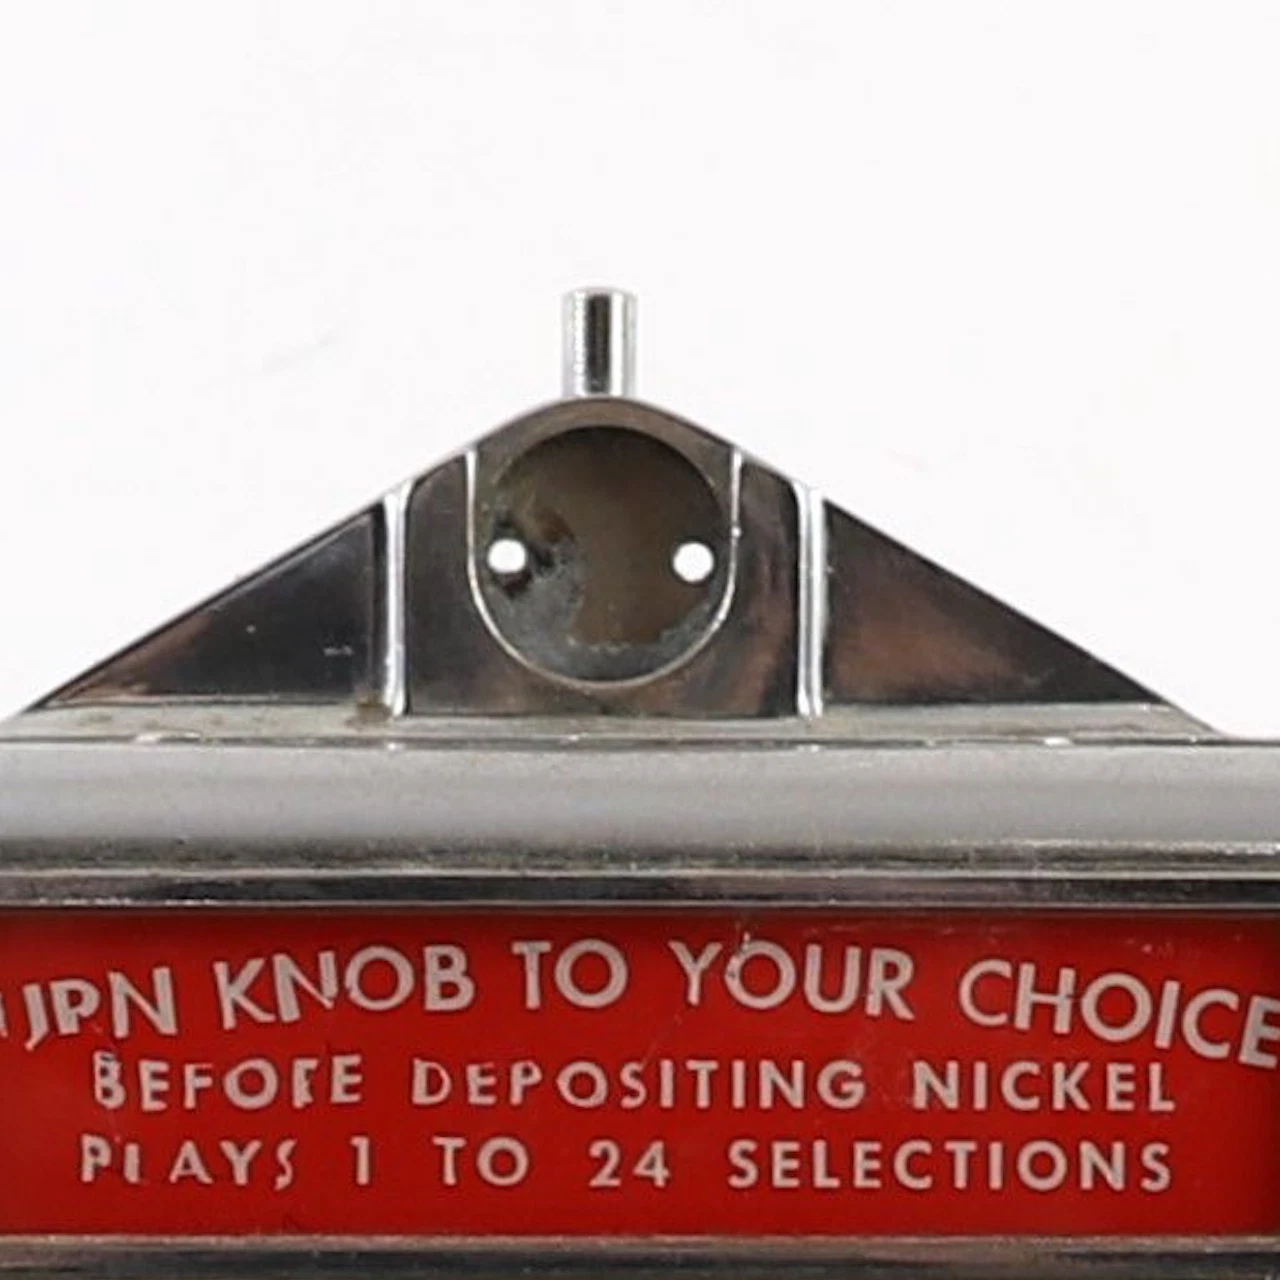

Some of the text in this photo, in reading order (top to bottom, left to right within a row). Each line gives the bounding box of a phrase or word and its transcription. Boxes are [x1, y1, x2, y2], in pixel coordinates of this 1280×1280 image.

[213, 945, 476, 1030] KNOB
[512, 938, 629, 1010] TO
[668, 940, 916, 1021] YOUR
[410, 1058, 866, 1110] DEPOSITING
[913, 1060, 1176, 1112] NICKEL
[350, 1135, 372, 1186] 1
[432, 1136, 529, 1187] TO
[589, 1140, 671, 1188] 24
[727, 1140, 1172, 1193] SELECTIONS
